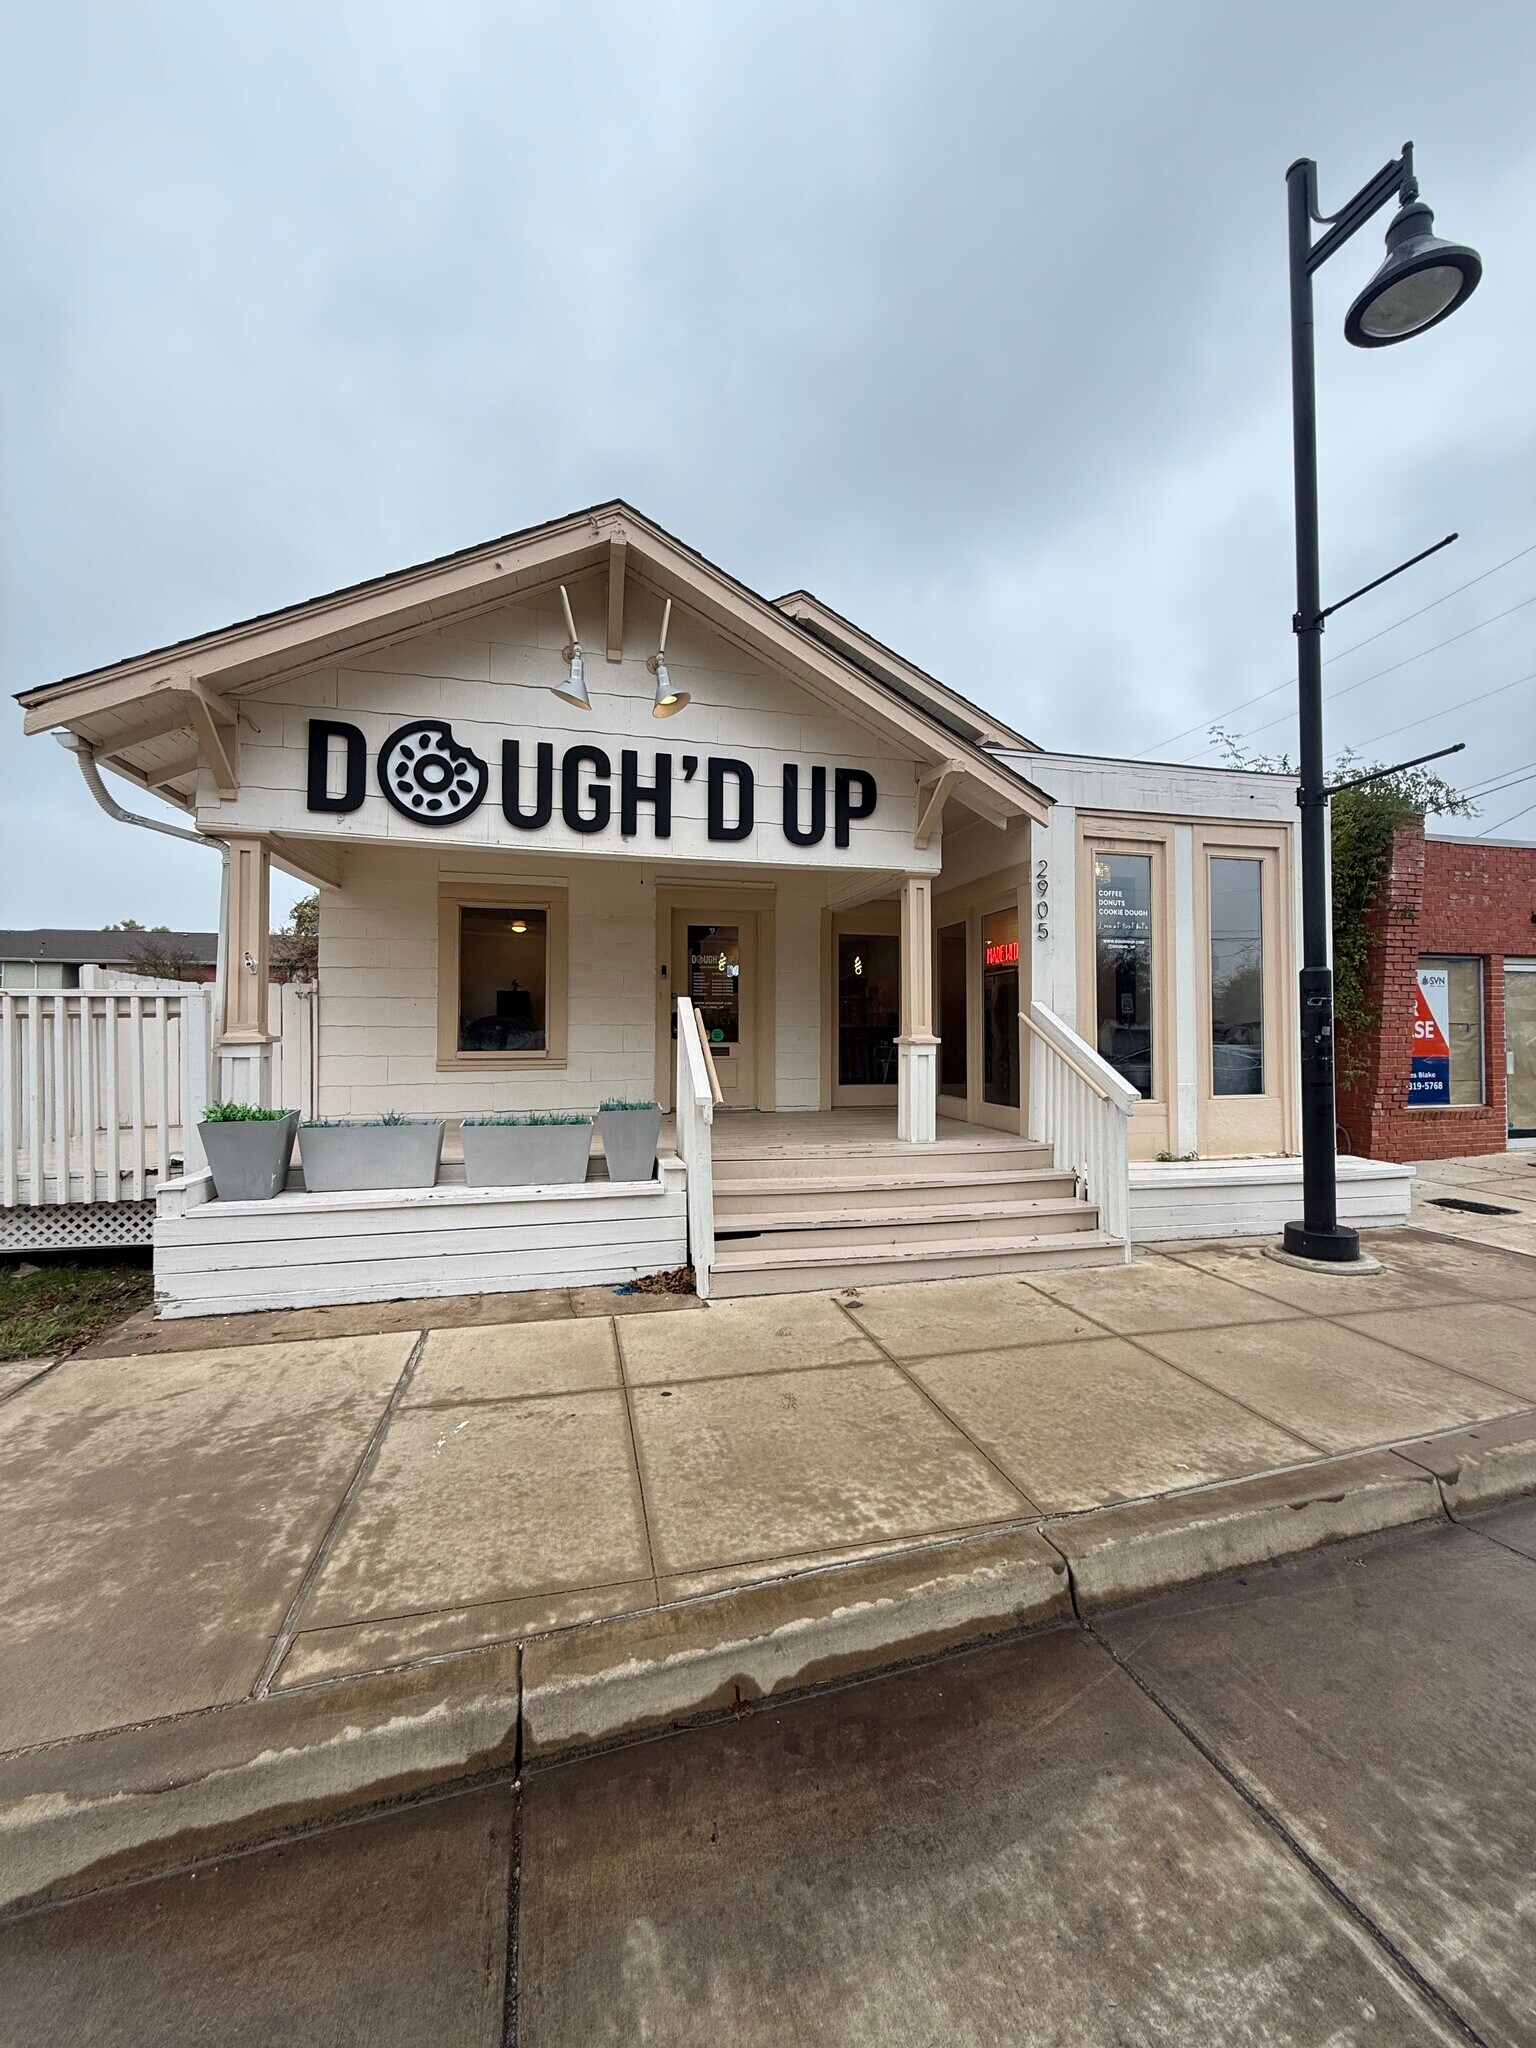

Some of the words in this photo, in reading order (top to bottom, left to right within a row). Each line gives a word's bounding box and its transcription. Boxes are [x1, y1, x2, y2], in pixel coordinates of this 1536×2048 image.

[306, 718, 755, 841] DOUGH'D
[782, 763, 878, 848] UP
[1098, 890, 1123, 898] COFFEE
[1036, 860, 1049, 940] 2905
[1098, 899, 1126, 907] DONUTS
[1098, 908, 1124, 916] COOKIE
[1124, 909, 1148, 917] DOUGH
[986, 944, 1004, 964] MADE
[691, 954, 726, 965] DOUGH'
[1429, 976, 1445, 985] SVN
[1412, 1020, 1434, 1038] SE
[1418, 1071, 1436, 1079] Blake
